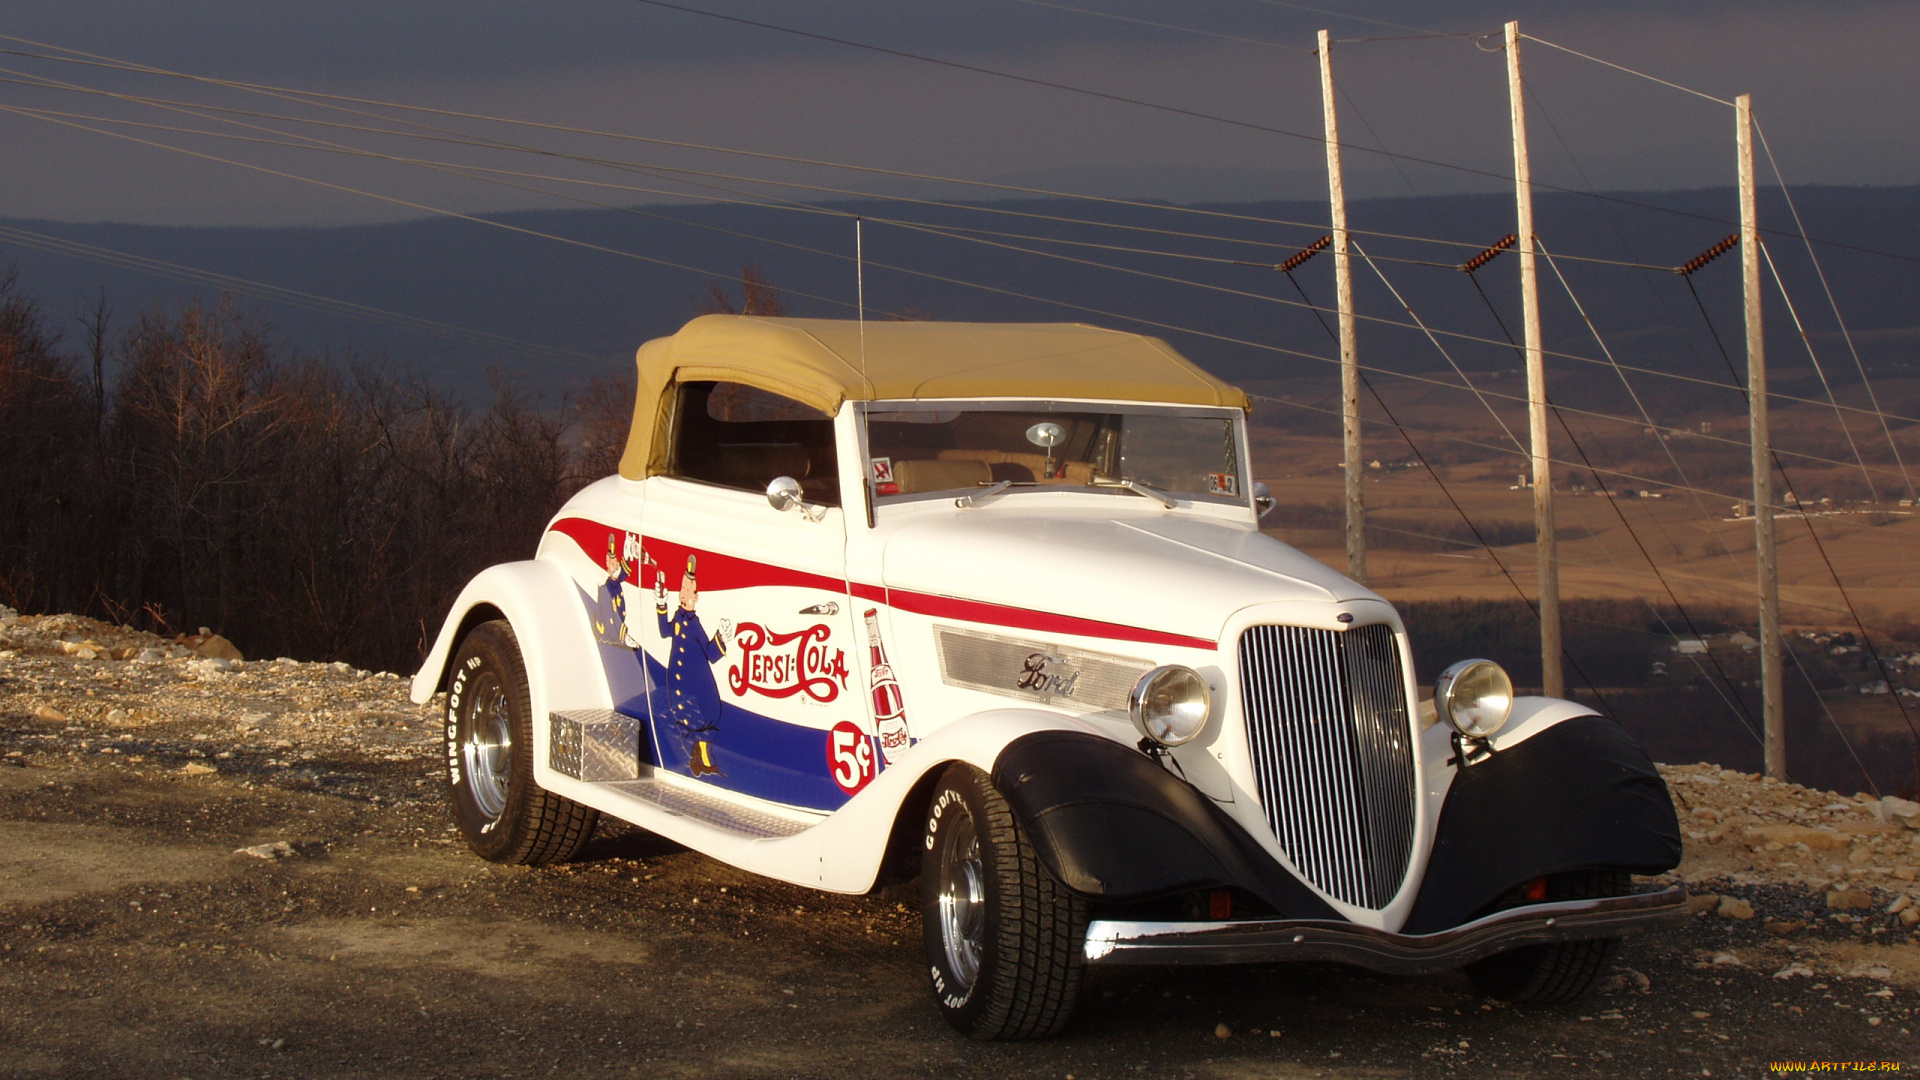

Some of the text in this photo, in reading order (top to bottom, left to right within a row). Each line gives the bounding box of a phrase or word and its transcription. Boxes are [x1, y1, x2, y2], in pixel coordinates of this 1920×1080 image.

[1017, 653, 1080, 698] Ford
[447, 656, 482, 785] WINGFOOT HP
[931, 965, 945, 994] HP
